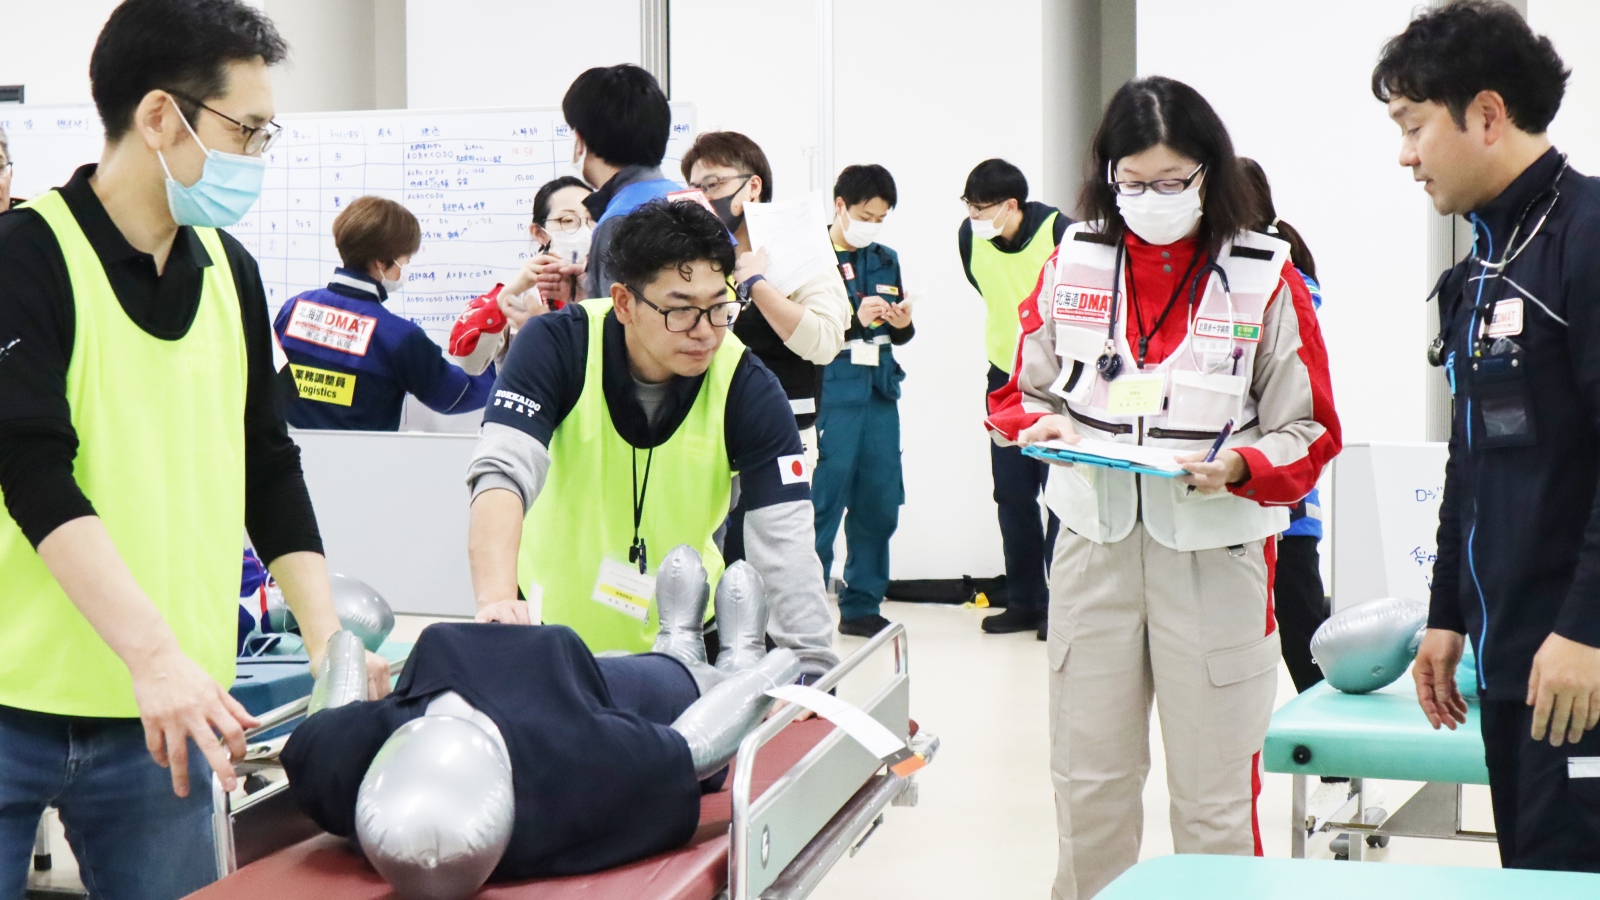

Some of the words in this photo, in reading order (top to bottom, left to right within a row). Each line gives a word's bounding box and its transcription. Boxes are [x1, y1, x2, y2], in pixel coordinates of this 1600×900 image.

[298, 306, 370, 334] 北海道DMAT
[295, 369, 346, 388] 業務調整員
[298, 383, 337, 398] Logistics
[494, 389, 542, 411] HOKKAIDO
